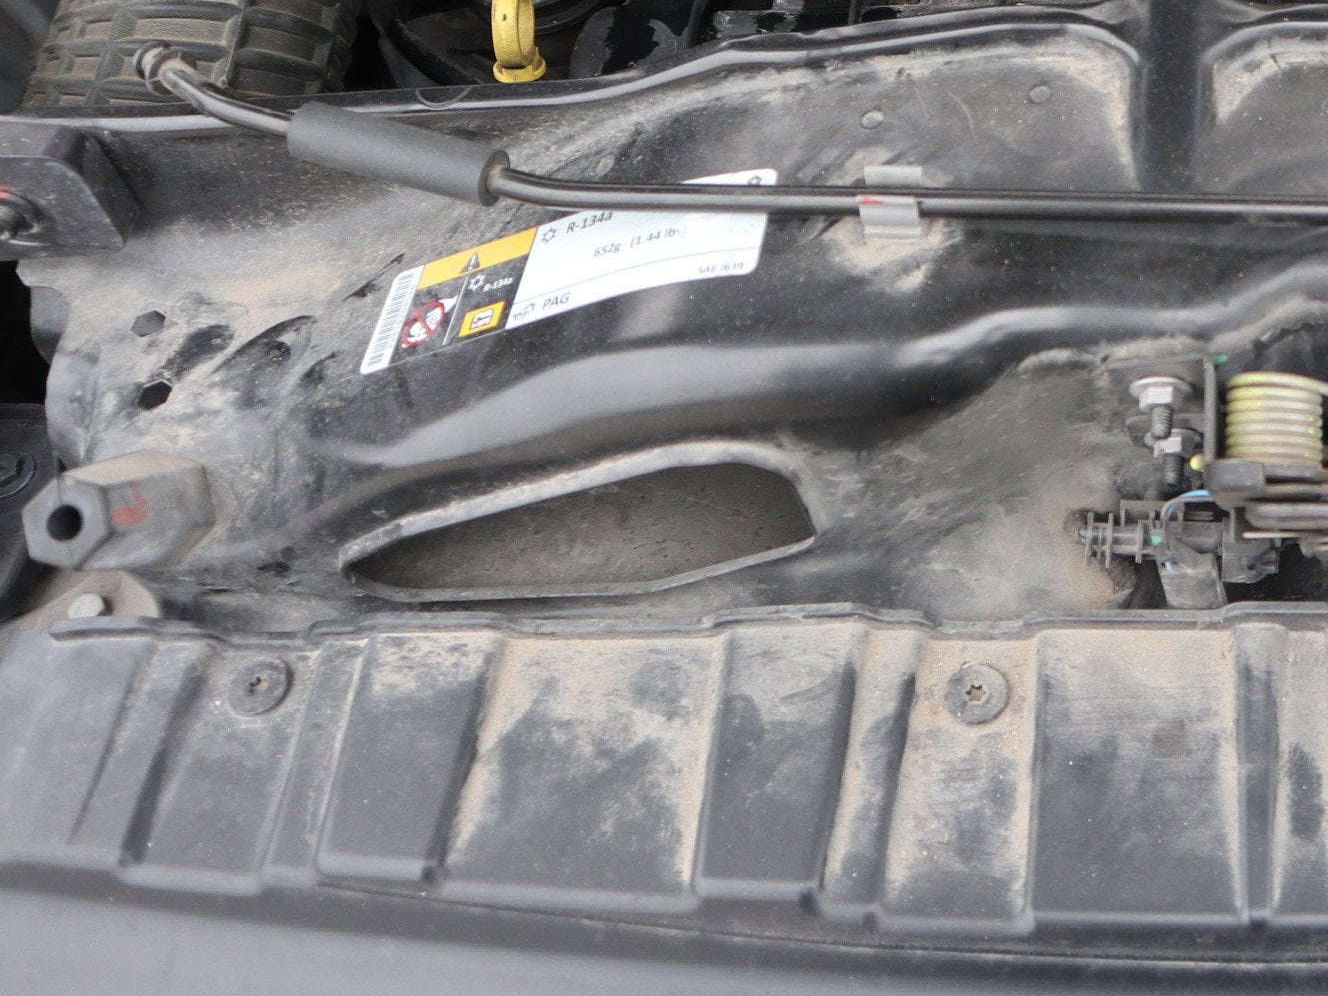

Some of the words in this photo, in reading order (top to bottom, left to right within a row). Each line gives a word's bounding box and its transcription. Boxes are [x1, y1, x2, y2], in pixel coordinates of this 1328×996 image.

[565, 211, 613, 234] R-134a
[630, 230, 661, 248] (1.44
[541, 291, 571, 310] PAG
